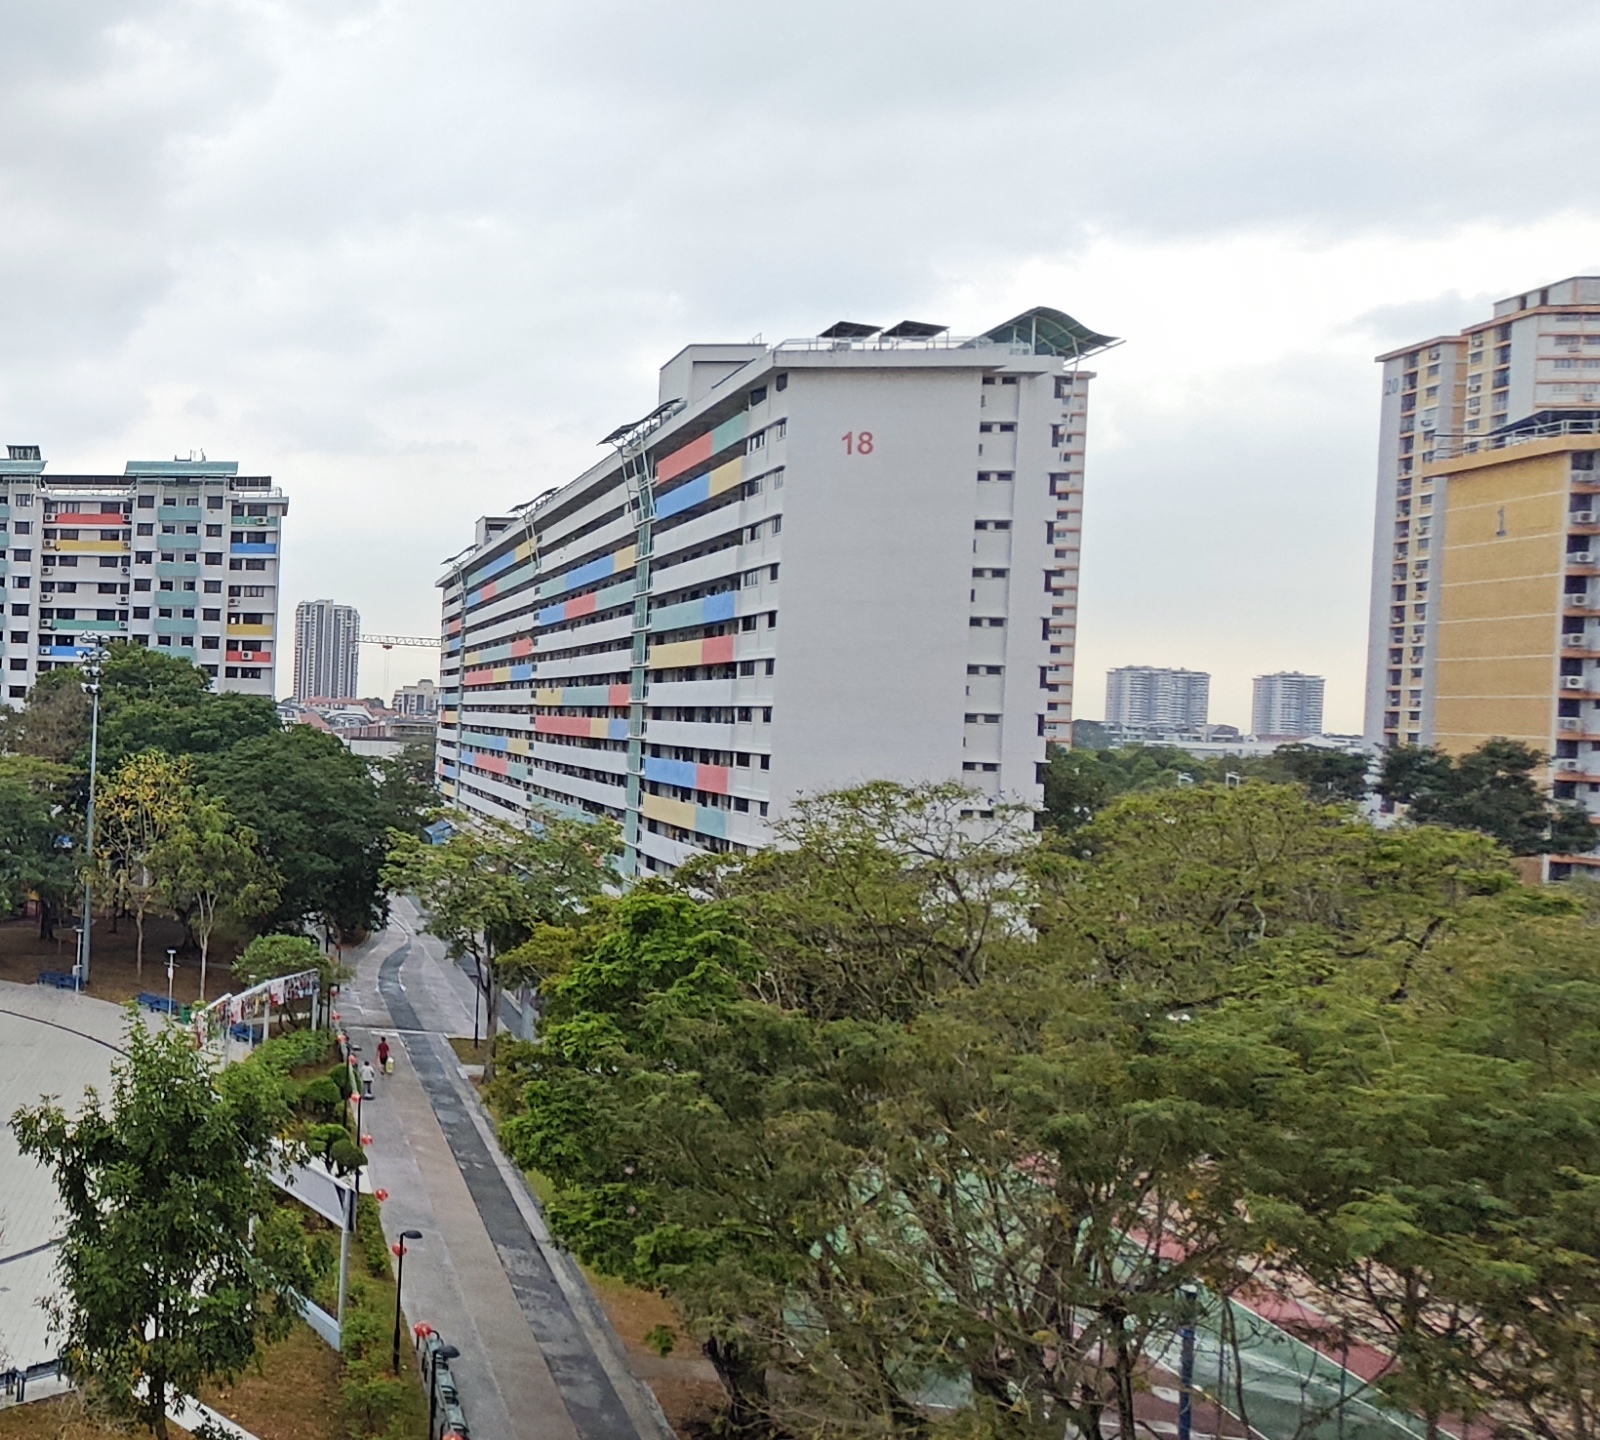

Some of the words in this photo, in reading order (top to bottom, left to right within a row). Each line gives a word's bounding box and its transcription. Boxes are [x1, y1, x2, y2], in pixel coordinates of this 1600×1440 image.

[1384, 378, 1399, 396] 20
[841, 431, 874, 455] 18
[1496, 505, 1507, 537] 1
